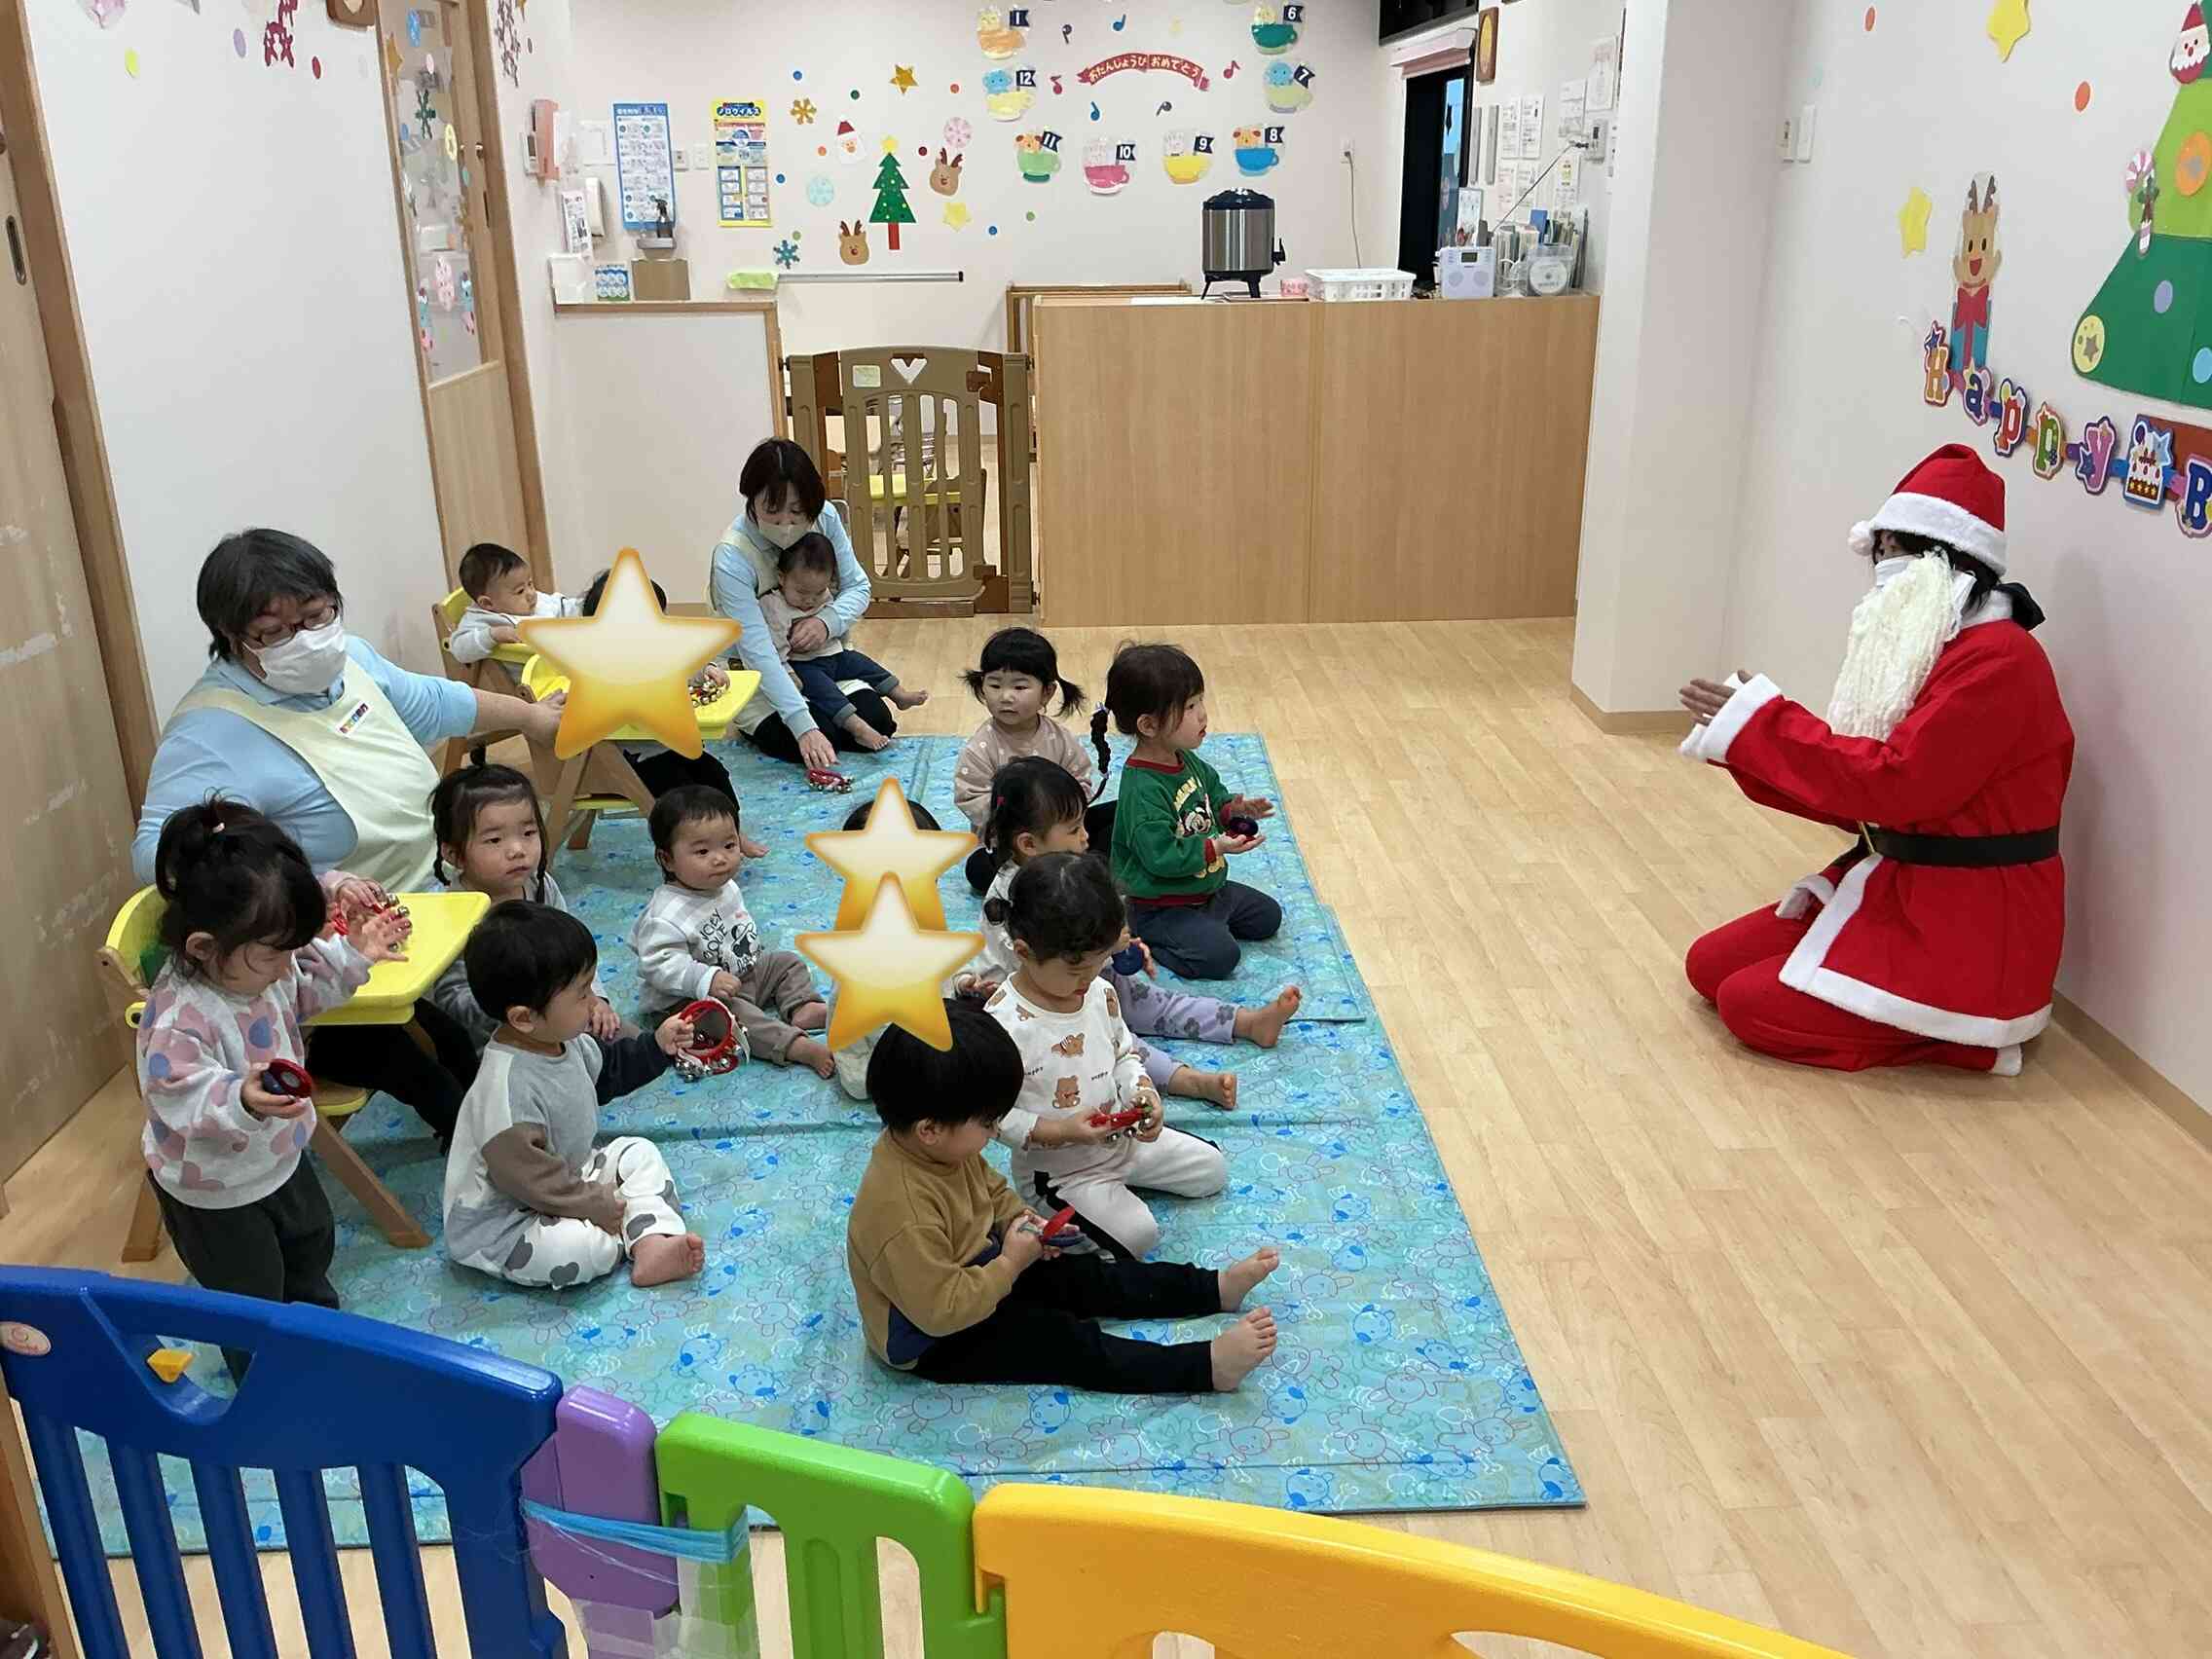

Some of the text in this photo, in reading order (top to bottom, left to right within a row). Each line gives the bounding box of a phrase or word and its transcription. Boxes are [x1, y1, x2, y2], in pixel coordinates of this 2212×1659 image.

[1287, 6, 1297, 19] 6
[1019, 71, 1032, 85] 12
[1298, 68, 1309, 81] 7
[1043, 132, 1056, 148] 11
[1269, 128, 1278, 142] 8
[1198, 137, 1208, 151] 9
[1119, 145, 1131, 159] 10
